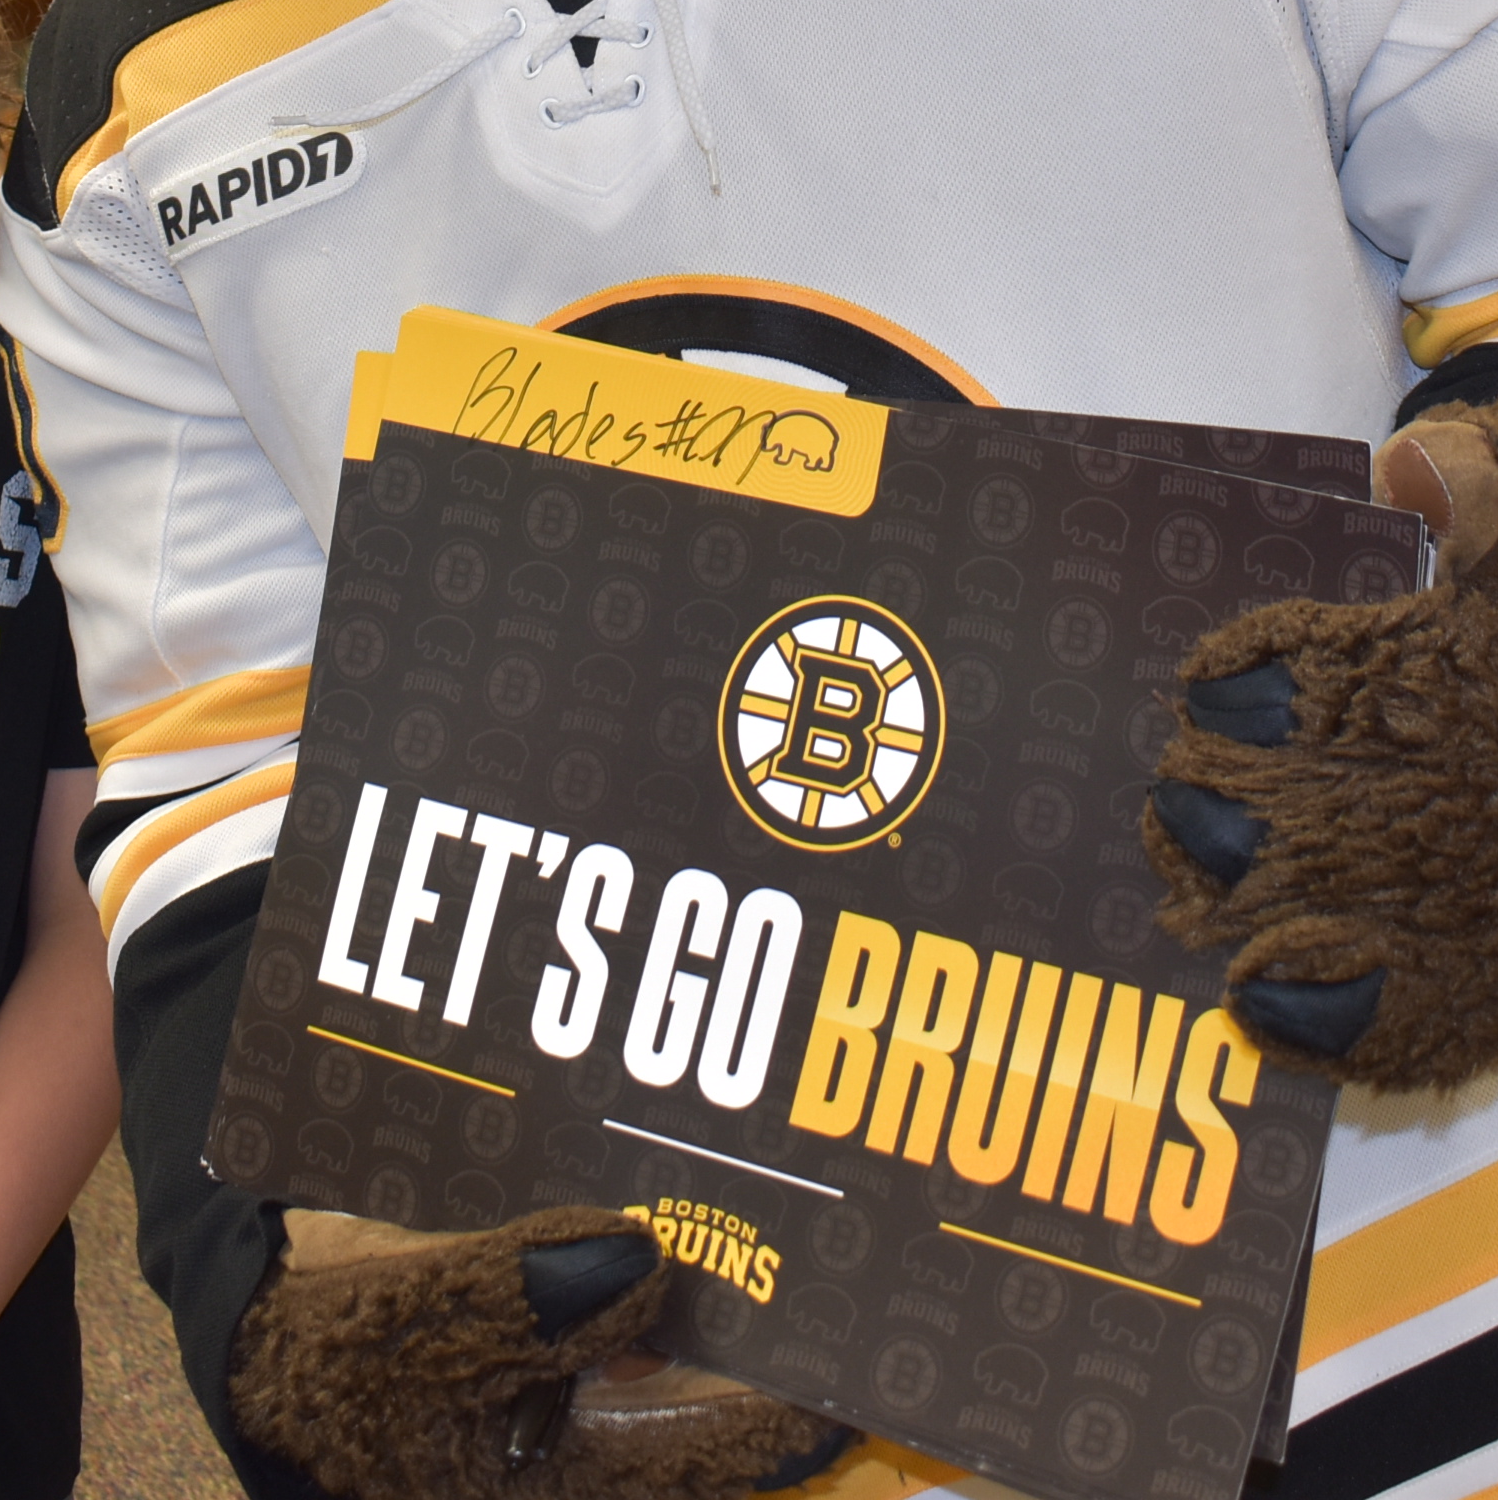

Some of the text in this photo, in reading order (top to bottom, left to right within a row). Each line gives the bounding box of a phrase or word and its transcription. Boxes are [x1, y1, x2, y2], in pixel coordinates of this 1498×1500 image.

[158, 129, 355, 248] RAPID7
[769, 646, 890, 797] B
[317, 781, 1263, 1247] LET'S GO BRUINS
[657, 1197, 758, 1243] BOSTON
